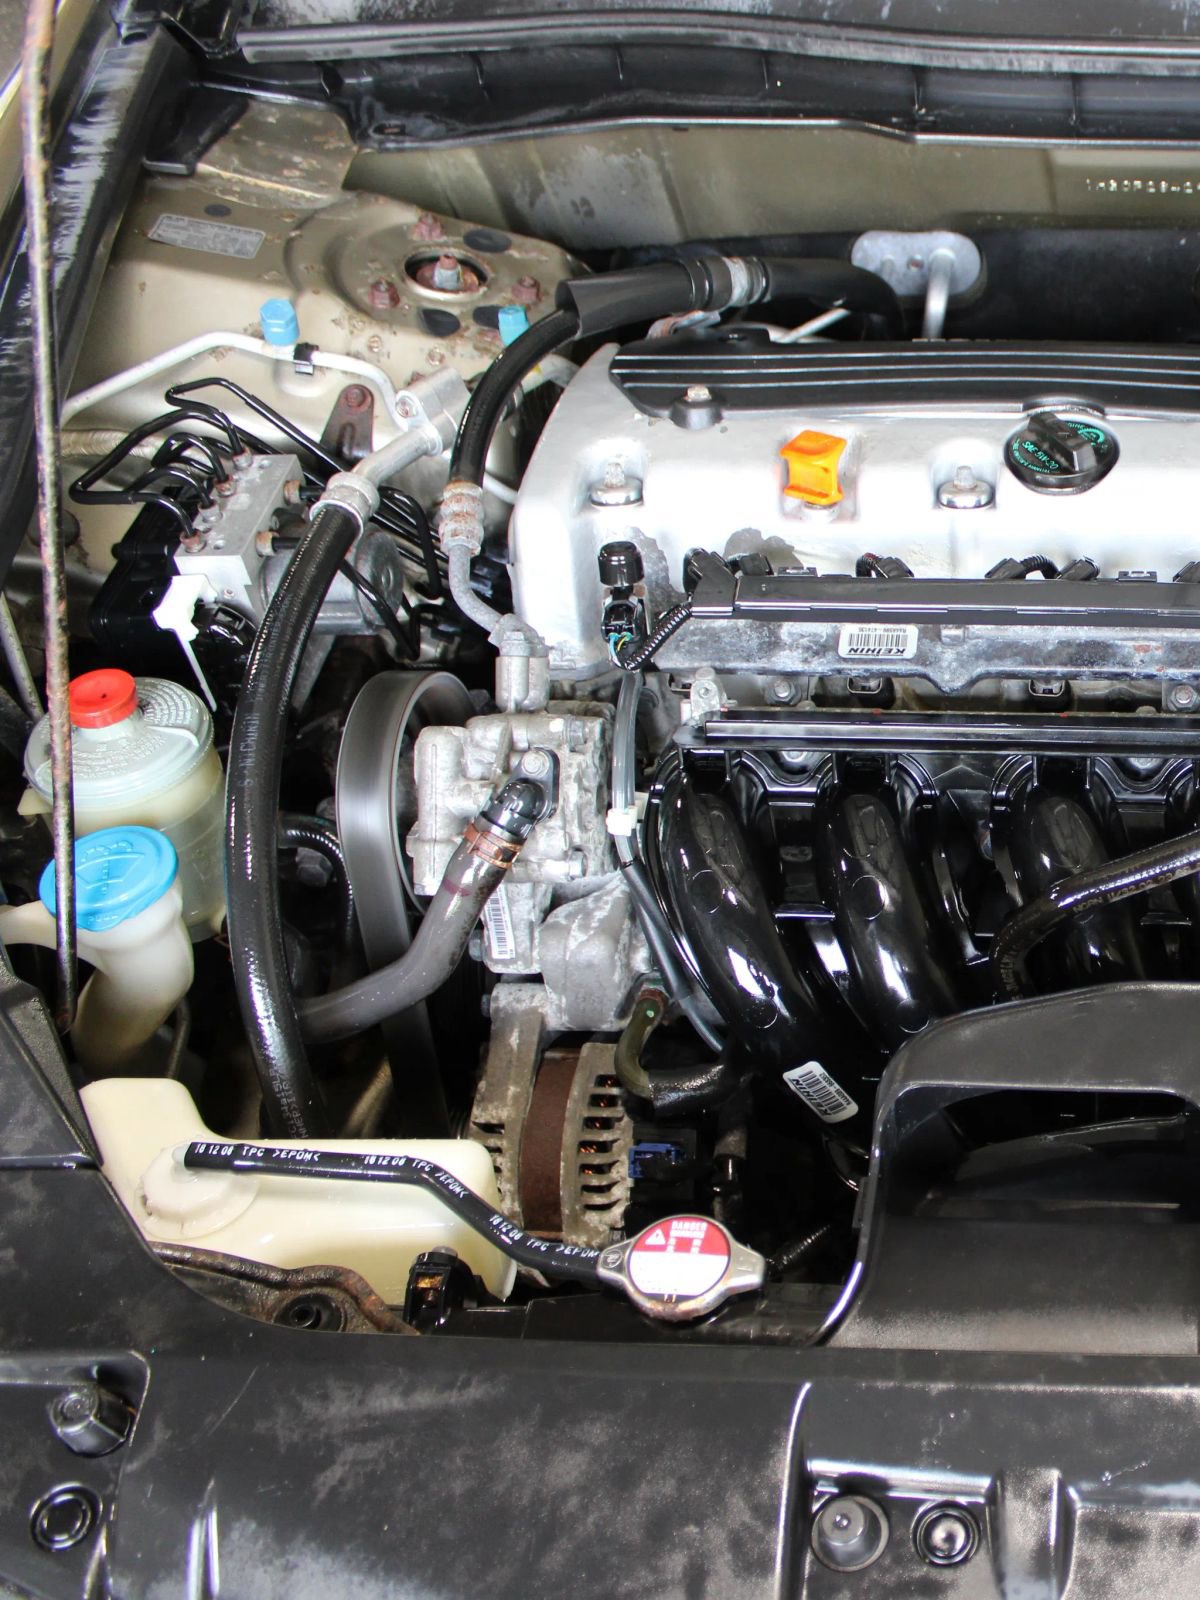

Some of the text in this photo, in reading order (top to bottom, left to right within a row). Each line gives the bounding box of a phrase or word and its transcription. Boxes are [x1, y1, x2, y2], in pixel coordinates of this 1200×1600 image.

[848, 647, 906, 655] KEIHIN
[208, 1144, 219, 1155] 12
[241, 1146, 266, 1157] TPC
[411, 1159, 434, 1171] TPC
[671, 1220, 708, 1231] DANGER
[526, 1238, 550, 1252] TPC
[555, 1243, 600, 1258] >EPDM
